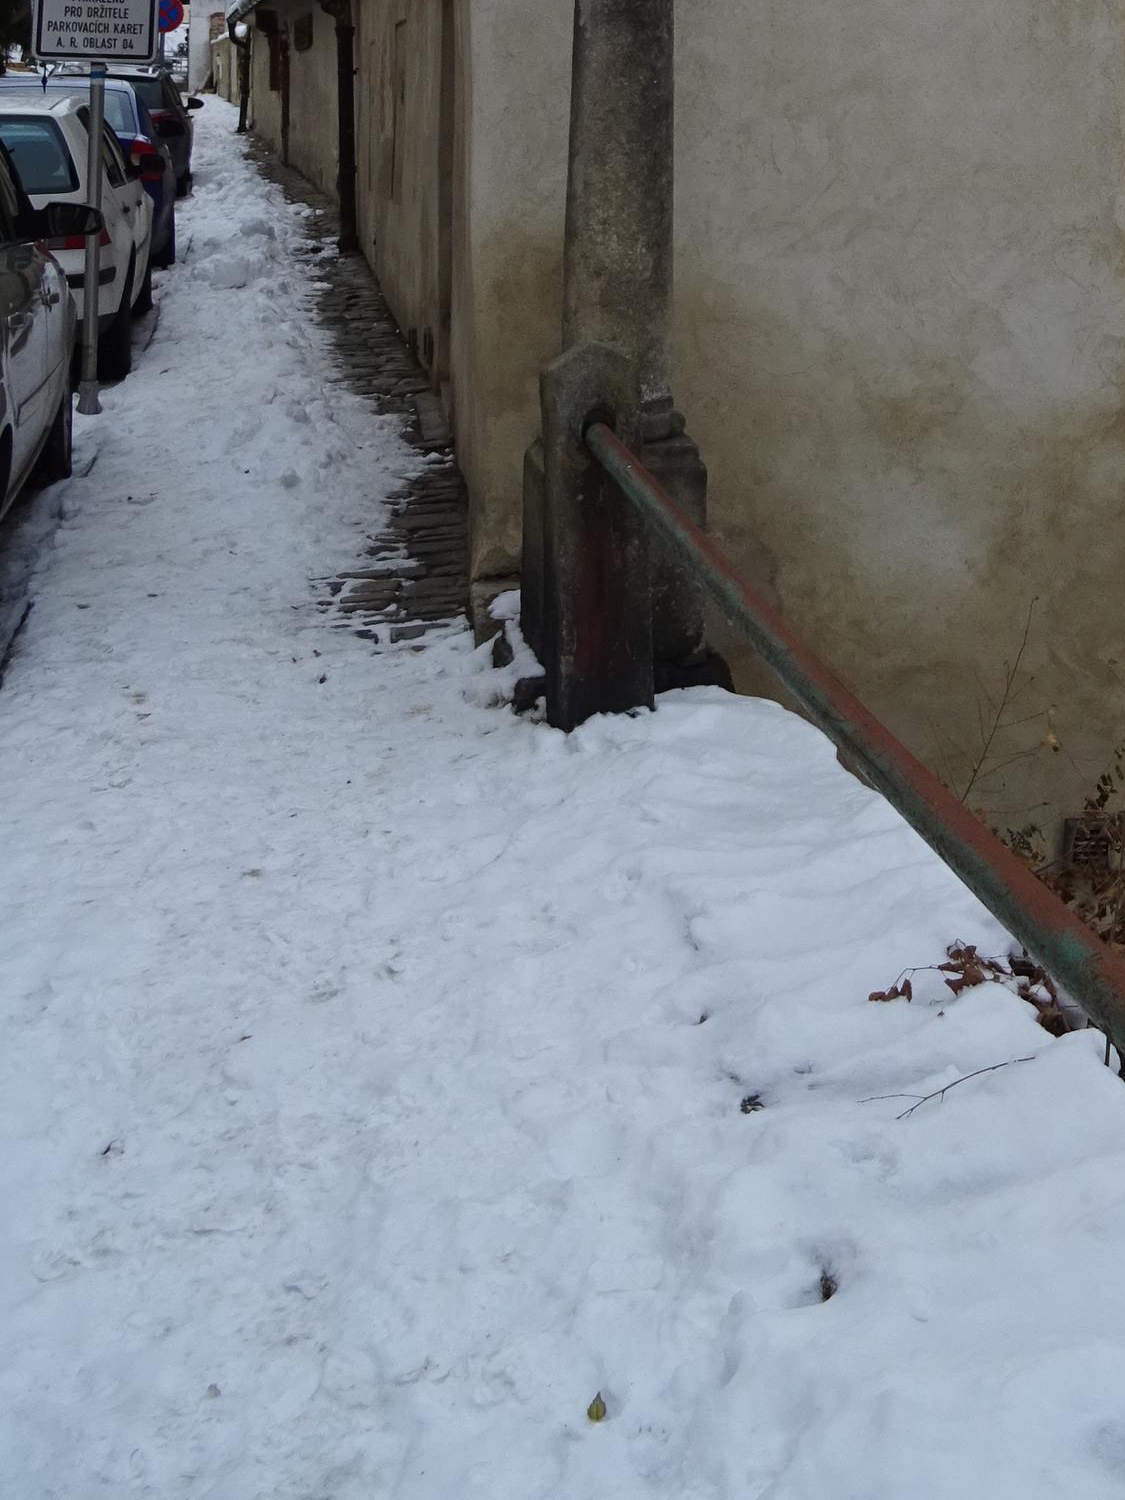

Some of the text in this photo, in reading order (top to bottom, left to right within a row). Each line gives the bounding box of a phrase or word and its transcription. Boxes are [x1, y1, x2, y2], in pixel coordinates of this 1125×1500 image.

[64, 5, 129, 19] PRO DRŽITELE
[47, 20, 144, 35] PARKOVACÍCH KARET
[83, 37, 117, 49] OBLAST
